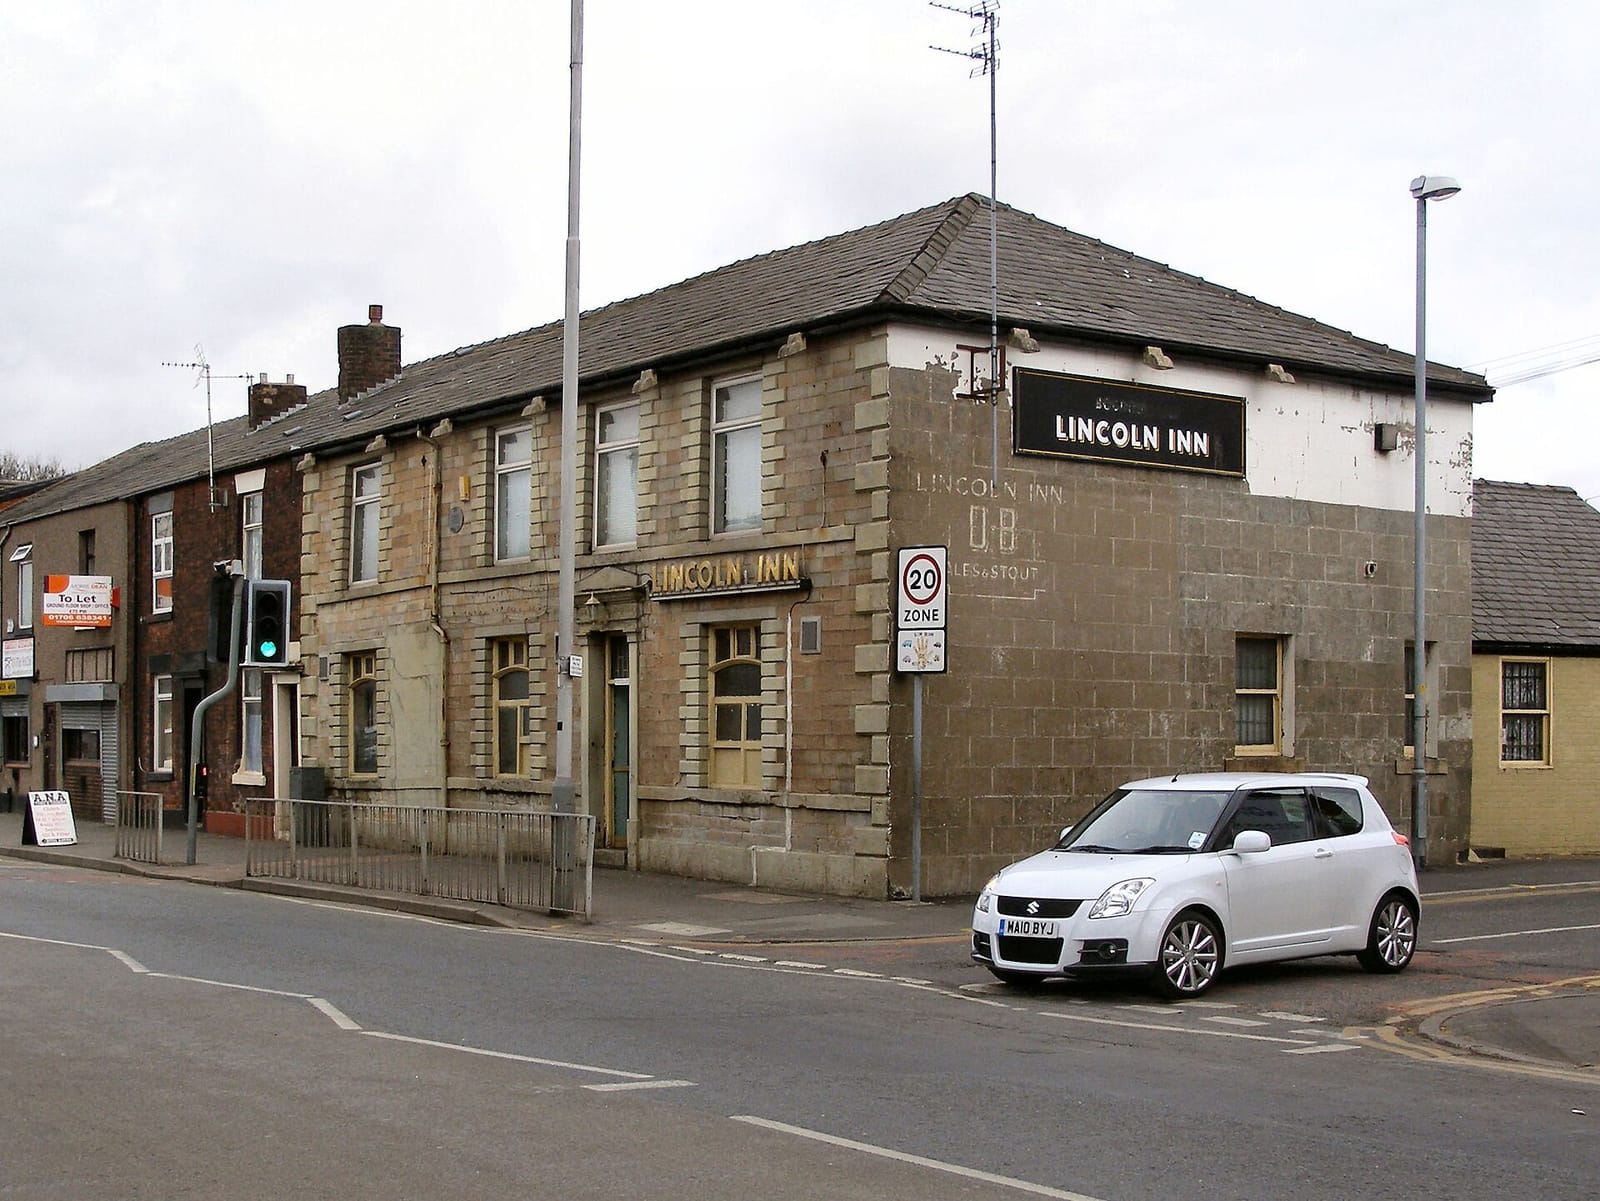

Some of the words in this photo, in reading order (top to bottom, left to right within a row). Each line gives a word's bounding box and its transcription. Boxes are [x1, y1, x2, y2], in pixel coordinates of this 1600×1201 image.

[1055, 414, 1160, 451] LINCOLN
[1168, 428, 1210, 458] INN
[916, 472, 1018, 500] LINCOLN
[651, 557, 743, 592] LINCOLN
[758, 551, 800, 584] INN
[909, 569, 936, 590] 20
[58, 594, 73, 603] To
[77, 594, 97, 603] Let
[904, 609, 939, 622] ZONE
[1007, 920, 1030, 934] MA10
[1033, 921, 1054, 935] BYJ
